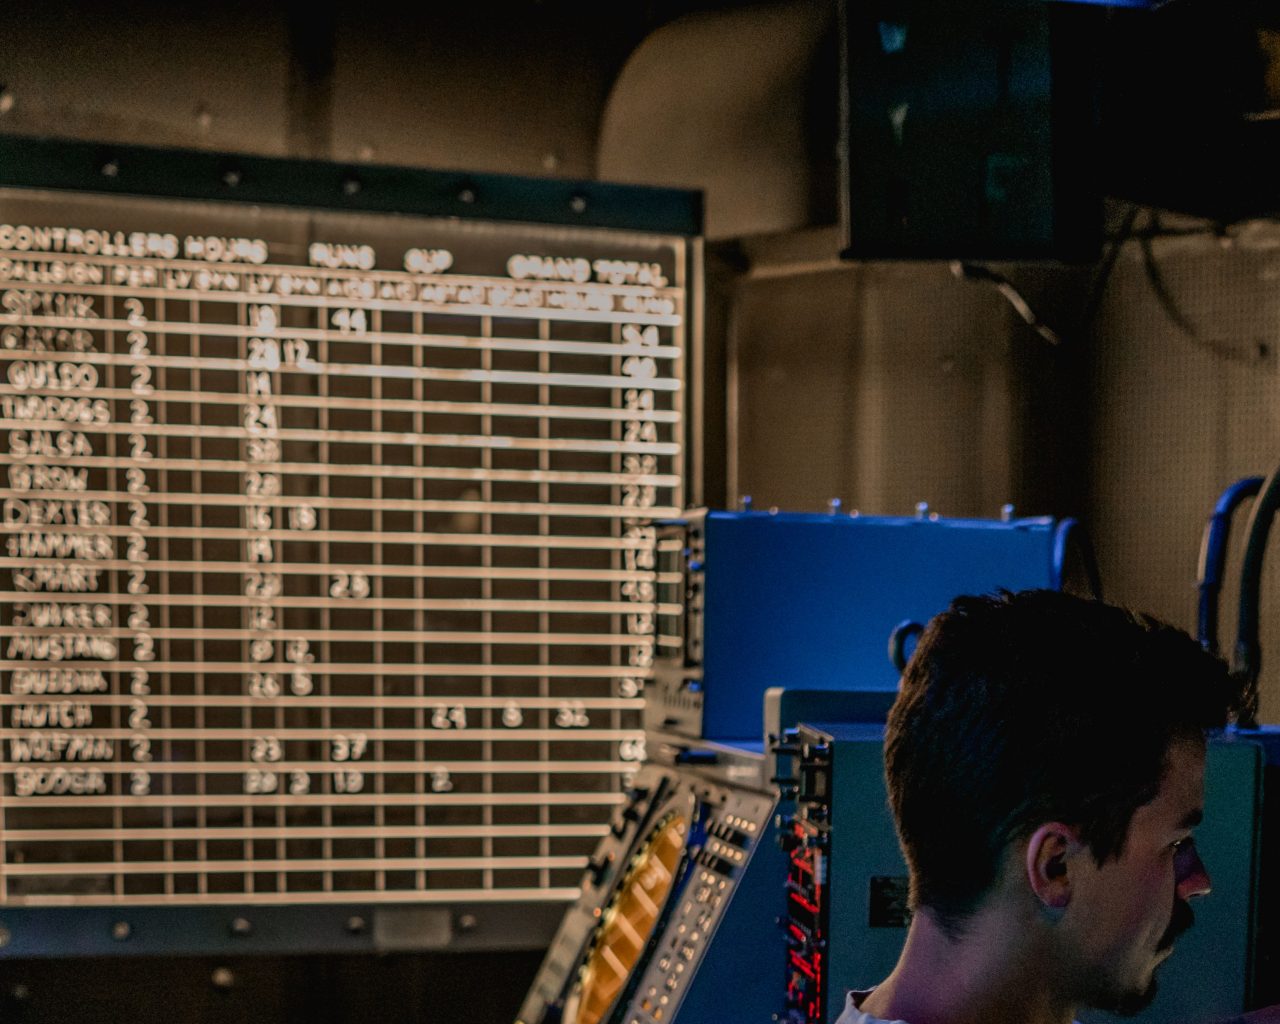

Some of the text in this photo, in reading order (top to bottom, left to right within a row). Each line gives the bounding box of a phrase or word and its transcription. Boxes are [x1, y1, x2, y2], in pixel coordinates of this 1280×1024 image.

[0, 224, 268, 264] CONTROLLERS HOURS
[507, 254, 668, 288] GRAND TOTAL
[124, 298, 147, 326] 2
[127, 330, 151, 359] 2
[7, 360, 154, 395] GUIDO 2
[129, 399, 154, 425] 2
[9, 430, 153, 461] SALSA 2
[126, 467, 150, 494] 2
[3, 498, 111, 529] DEXTER
[128, 500, 150, 529] 2
[127, 532, 149, 562] 2
[127, 565, 150, 594] 2
[128, 603, 150, 630] 2
[7, 632, 117, 662] MUSTANG
[133, 632, 155, 662] 2
[130, 667, 151, 695] 2
[11, 700, 93, 728] HUTCH
[129, 699, 152, 729] 2
[130, 733, 153, 762] 2
[332, 733, 368, 761] 37
[130, 768, 151, 795] 2
